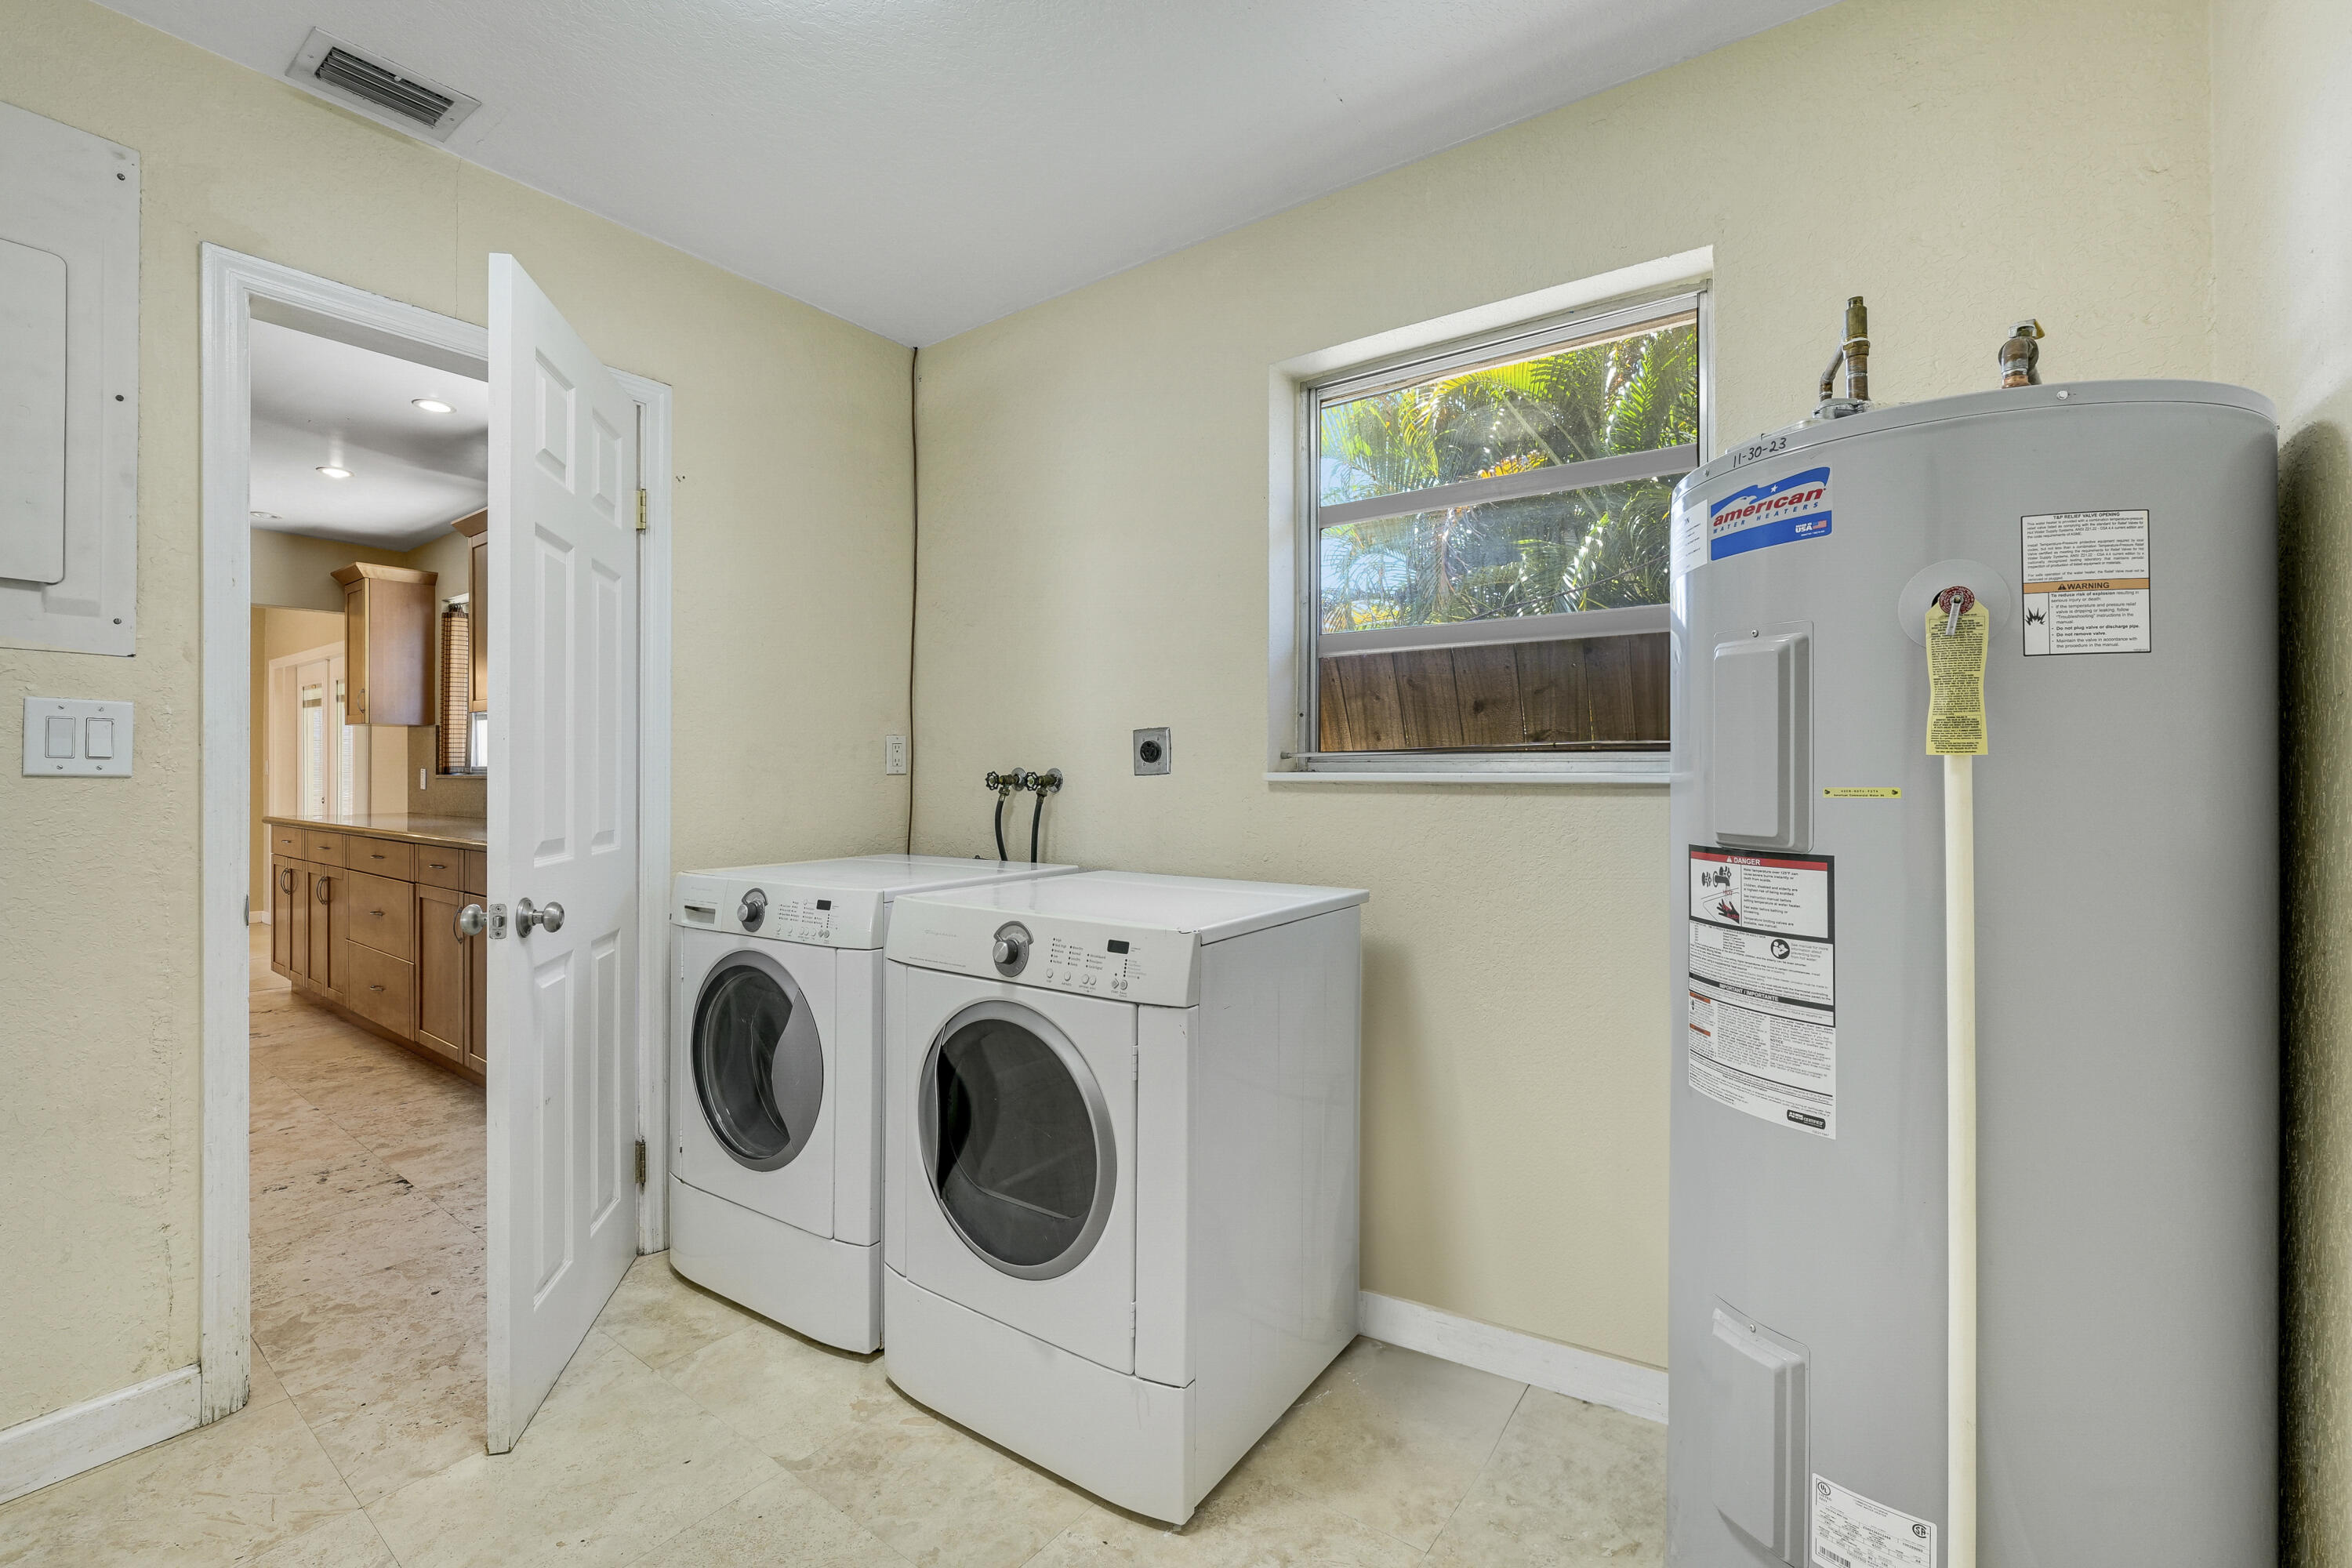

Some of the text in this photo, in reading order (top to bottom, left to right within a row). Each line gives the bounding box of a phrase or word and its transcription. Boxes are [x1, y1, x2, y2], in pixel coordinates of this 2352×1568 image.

[1733, 437, 1787, 468] 11-30-23
[1713, 488, 1823, 526] american
[1713, 502, 1818, 534] WATER HEATERS
[1734, 857, 1761, 865] DANGER
[1719, 983, 1743, 994] IMPORTANT
[1746, 990, 1779, 1002] IMPORTANTE
